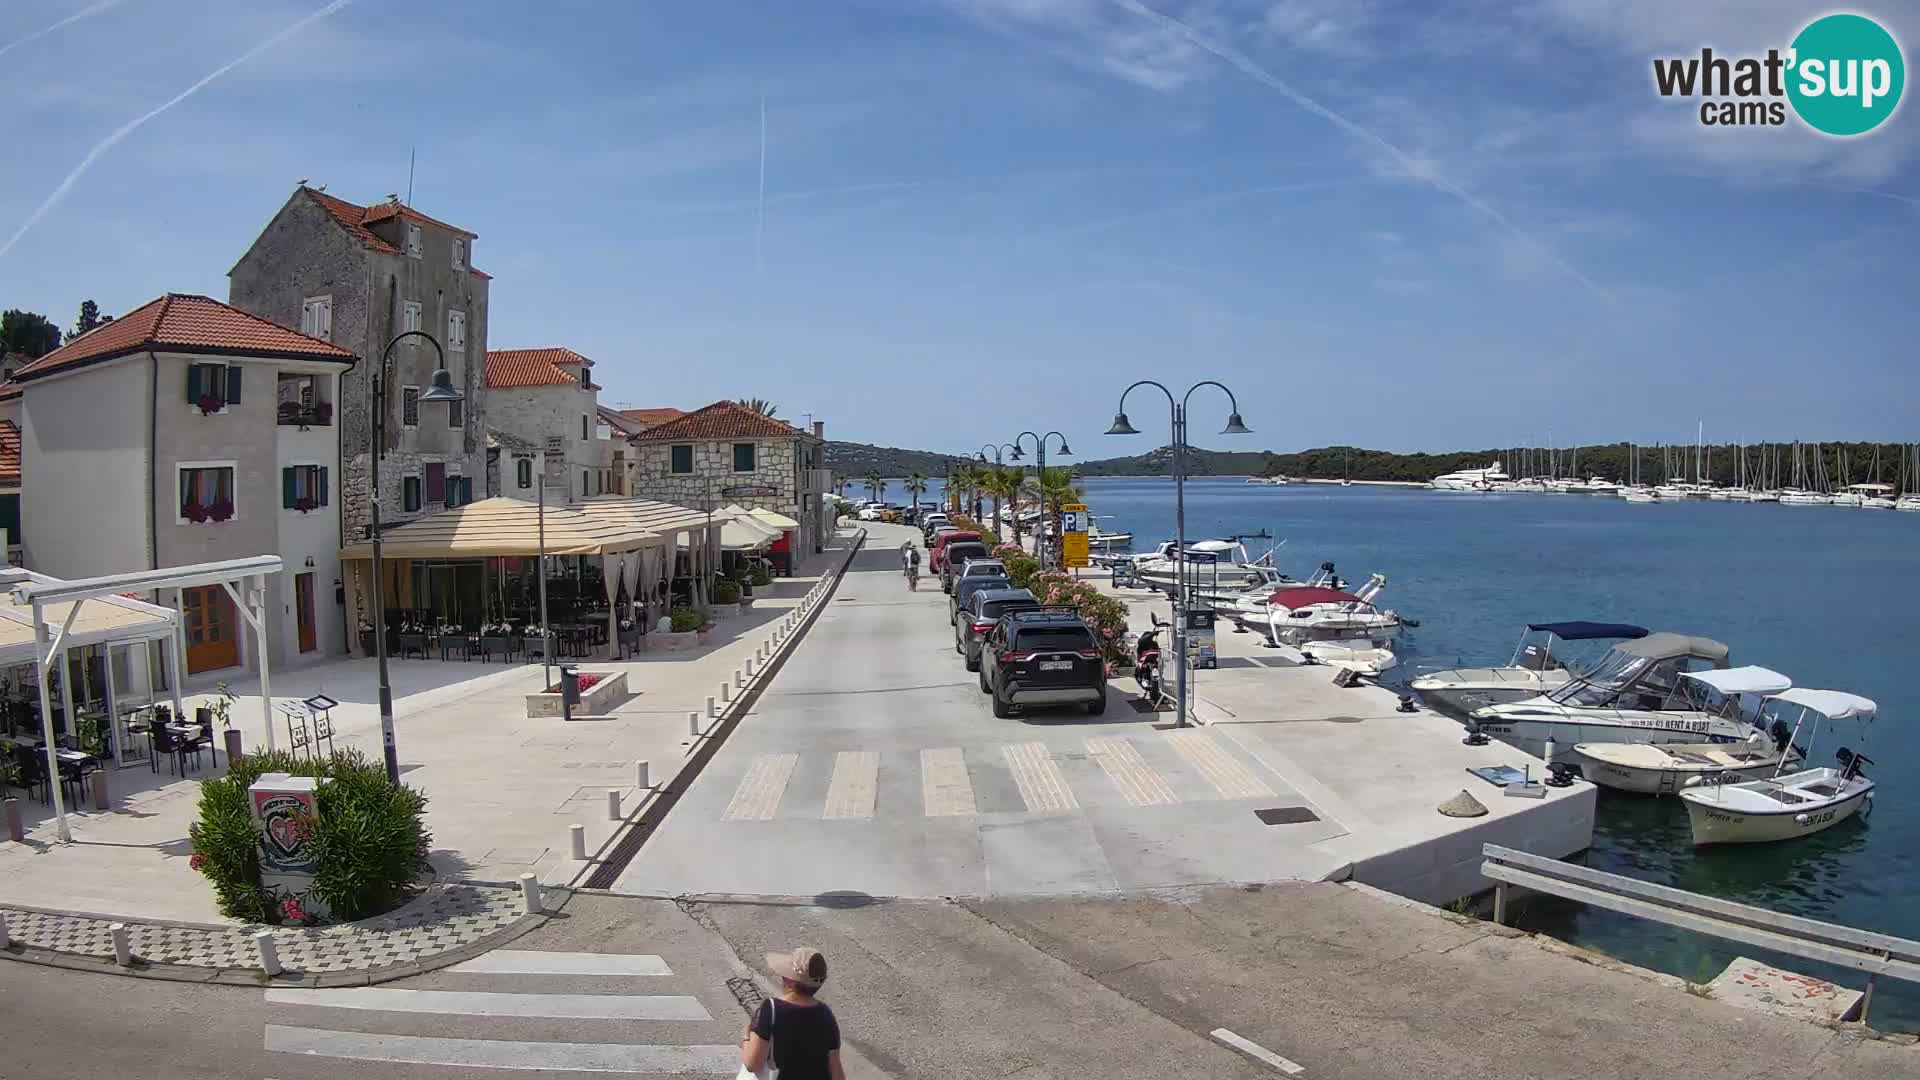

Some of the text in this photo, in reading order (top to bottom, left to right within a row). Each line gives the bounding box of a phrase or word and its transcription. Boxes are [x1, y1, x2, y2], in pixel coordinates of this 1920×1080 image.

[1065, 514, 1075, 530] P
[1665, 720, 1684, 730] RENT
[1691, 721, 1710, 733] BOAT
